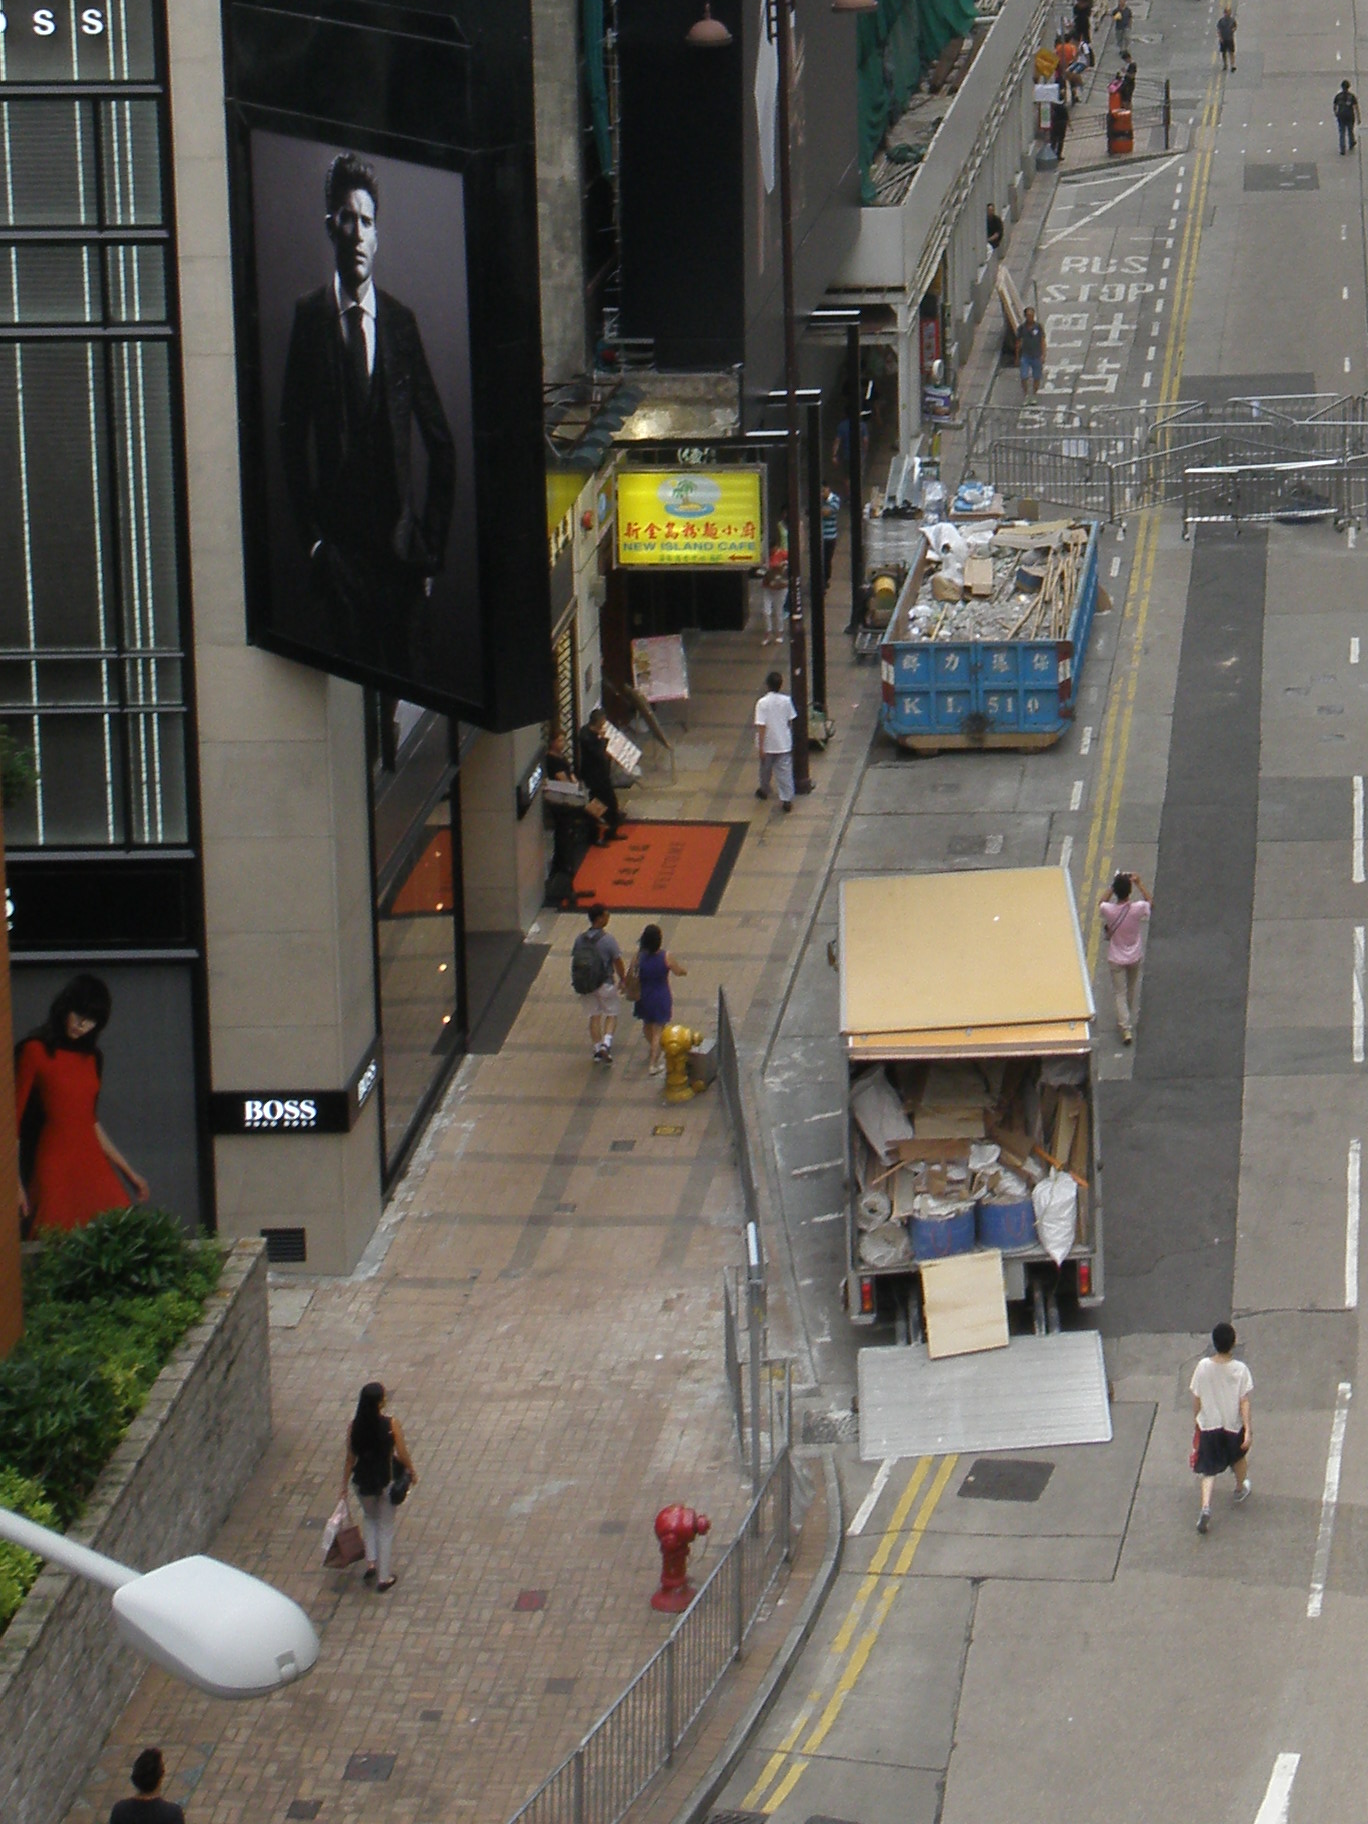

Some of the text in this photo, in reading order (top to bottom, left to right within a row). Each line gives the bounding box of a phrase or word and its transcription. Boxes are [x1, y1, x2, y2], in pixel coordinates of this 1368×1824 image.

[1041, 282, 1155, 303] STOP
[1044, 312, 1138, 348] 巴士
[623, 541, 756, 551] NEW ISLAND CAFE
[244, 1099, 318, 1121] BOSS
